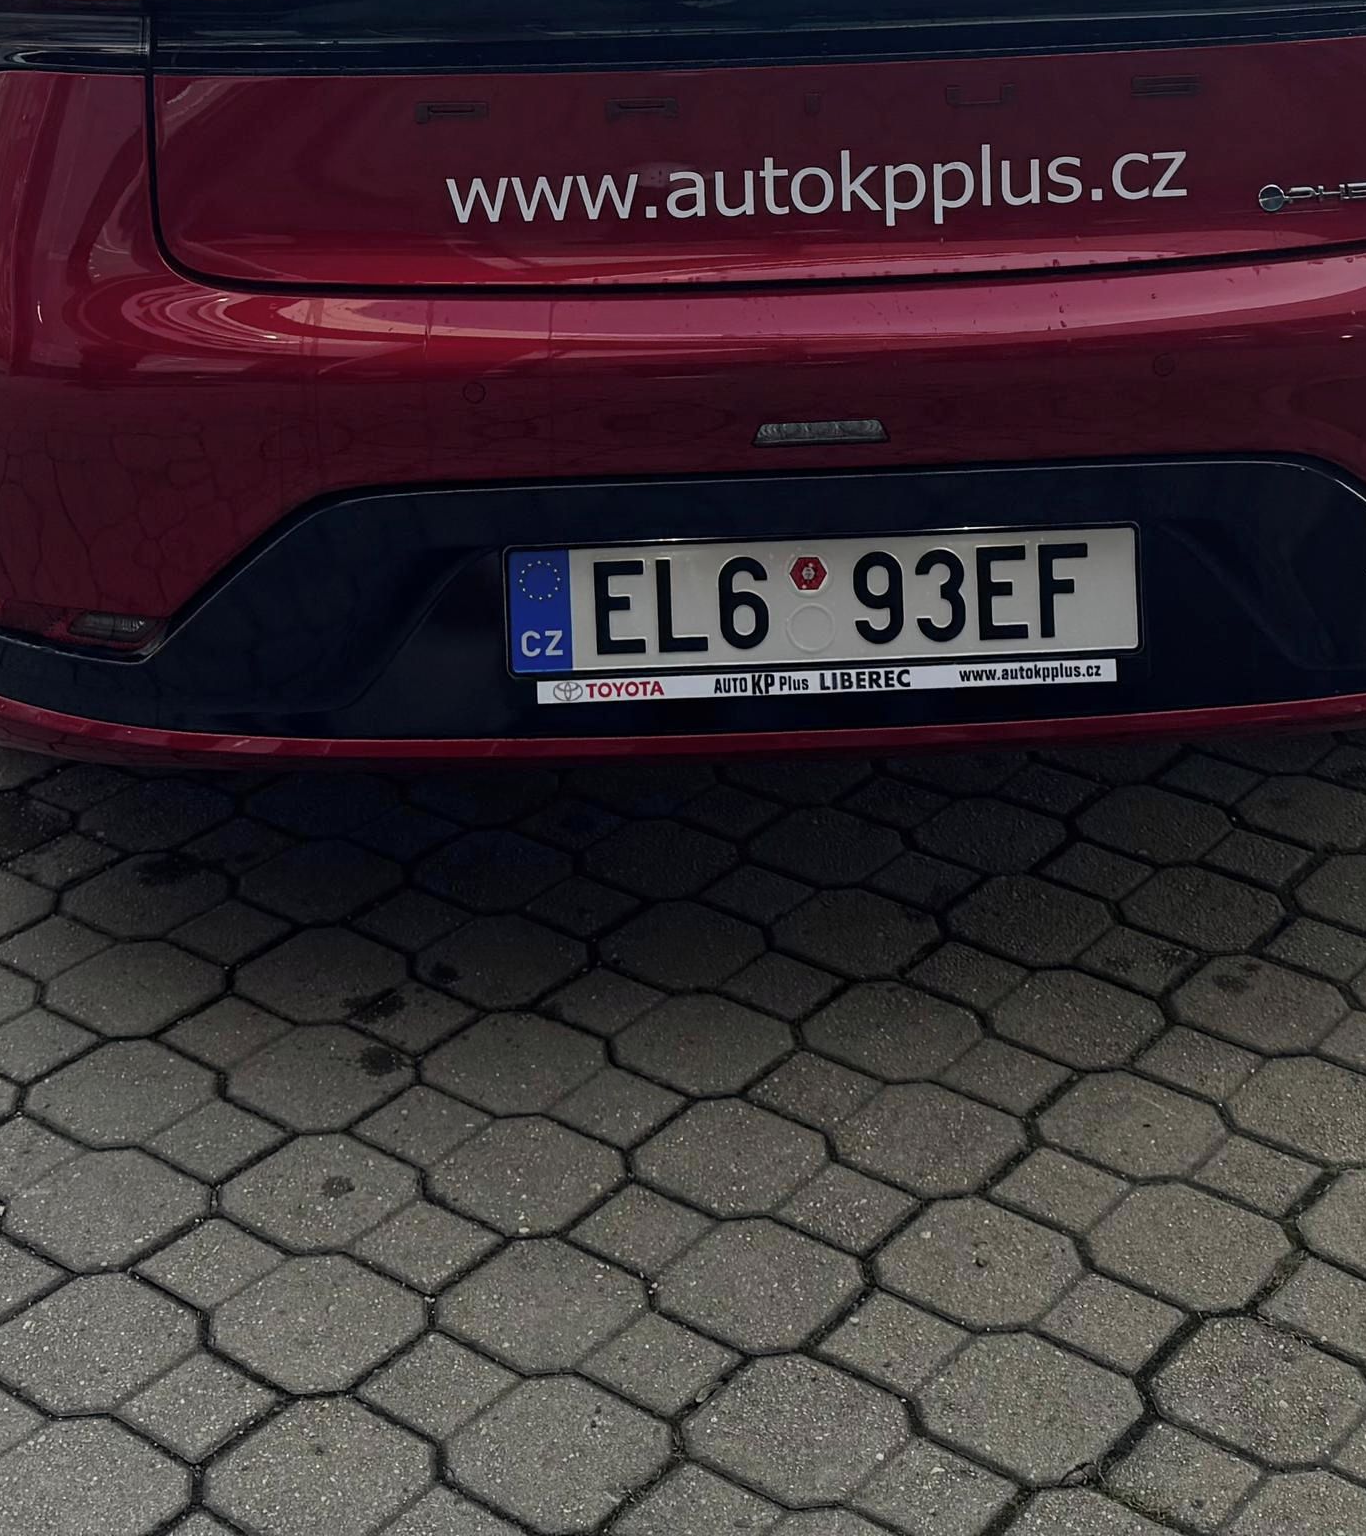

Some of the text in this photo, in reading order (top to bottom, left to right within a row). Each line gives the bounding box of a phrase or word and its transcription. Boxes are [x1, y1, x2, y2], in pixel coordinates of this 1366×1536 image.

[446, 143, 1188, 226] www.autokpplus.cz
[591, 542, 1089, 656] EL6 93EF
[520, 630, 564, 658] CZ
[585, 662, 1102, 699] TOYOTA AUTO KP Plus LIBEREC www.autokpplus.cz
